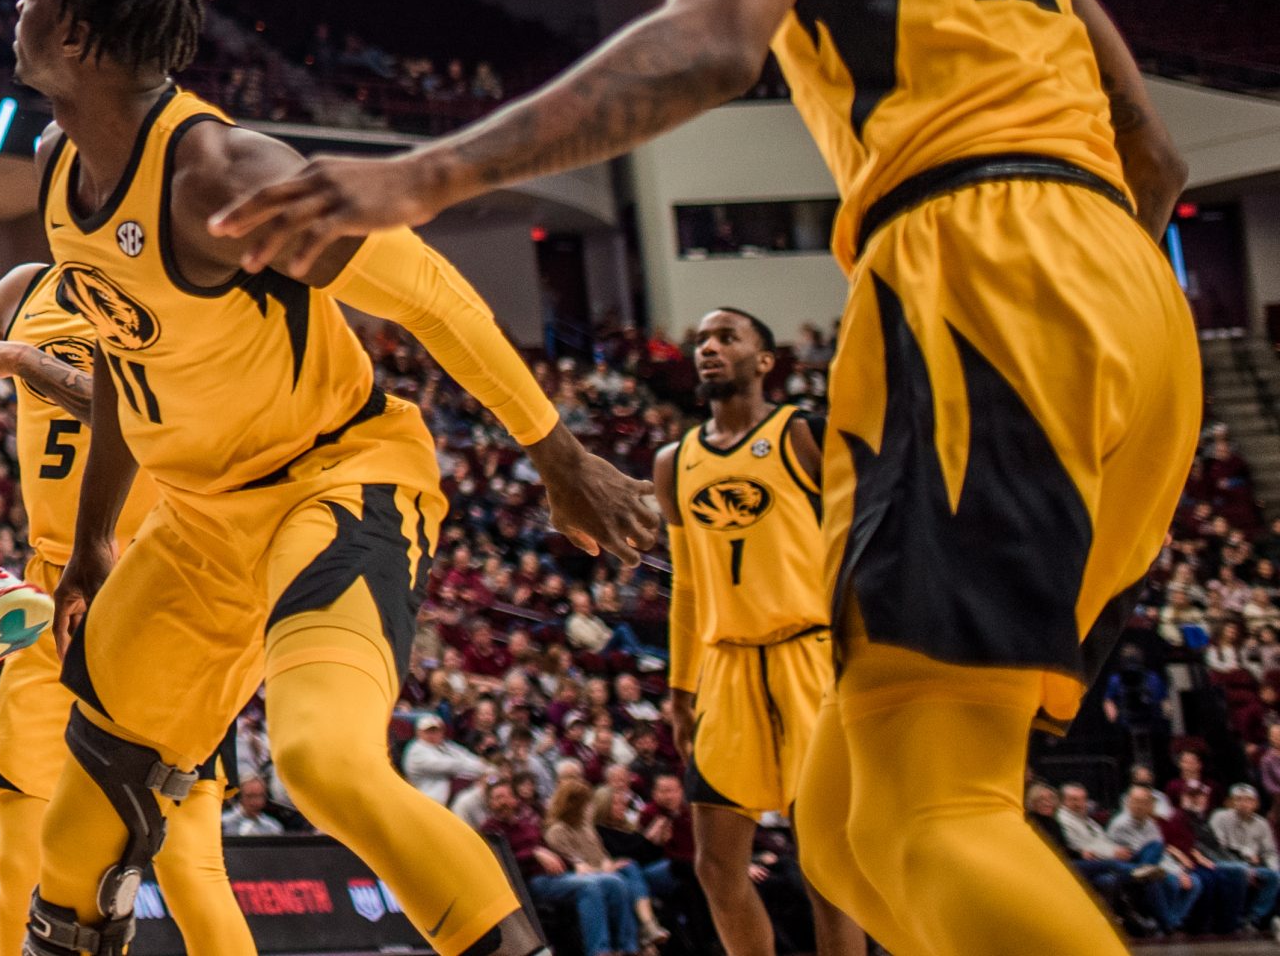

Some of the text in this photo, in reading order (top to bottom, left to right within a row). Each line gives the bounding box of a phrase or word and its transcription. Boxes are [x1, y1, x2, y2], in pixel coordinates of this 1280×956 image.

[117, 222, 143, 256] SEC
[108, 352, 163, 425] 11
[39, 419, 82, 480] 5
[730, 538, 745, 585] 1
